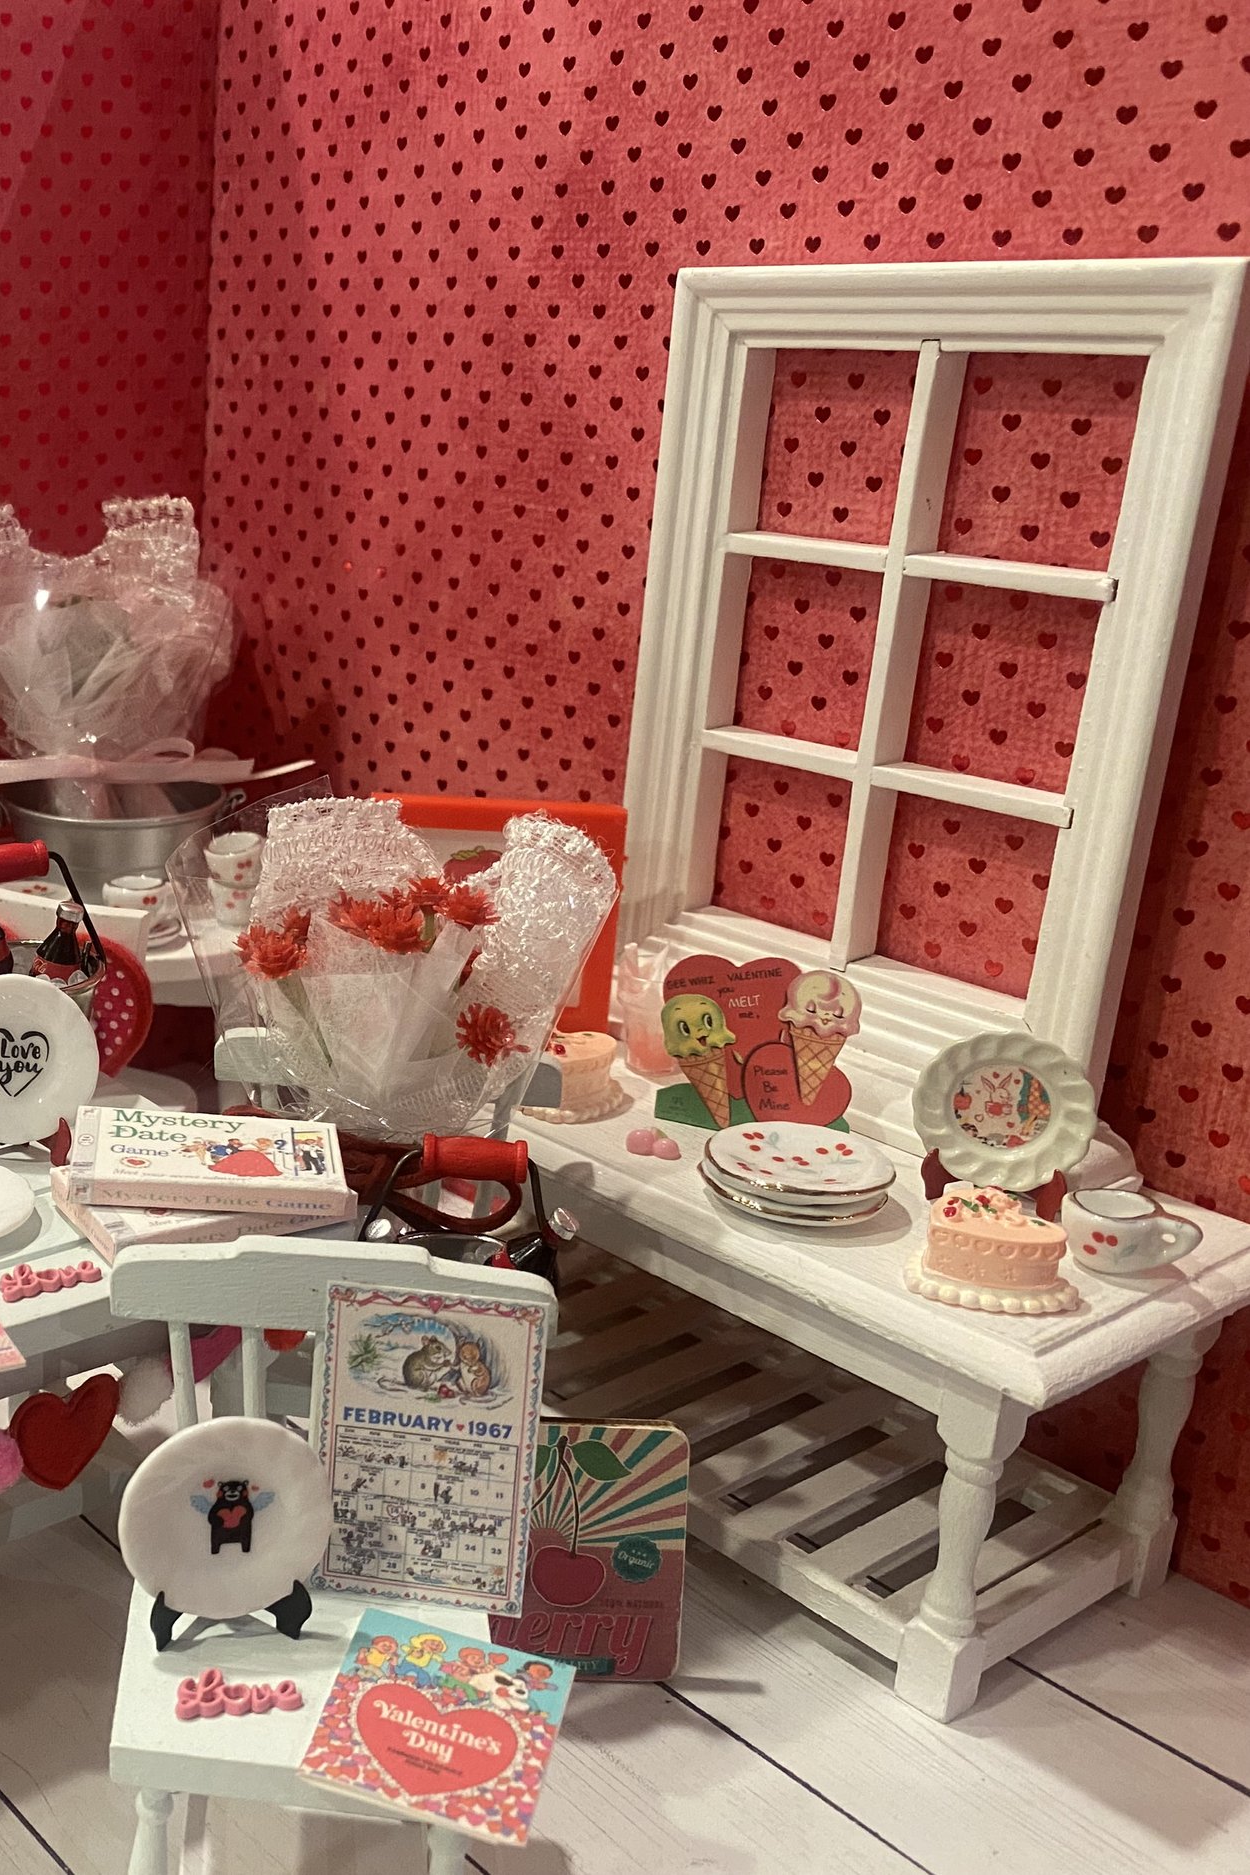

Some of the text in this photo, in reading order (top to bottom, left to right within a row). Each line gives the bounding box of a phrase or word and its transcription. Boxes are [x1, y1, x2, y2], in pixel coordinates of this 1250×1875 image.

[726, 967, 783, 982] VALENTINE
[728, 994, 761, 1009] MELT
[0, 1038, 41, 1060] Love
[753, 1065, 788, 1077] Please
[762, 1080, 778, 1093] Be
[759, 1098, 790, 1111] Mine
[113, 1108, 245, 1134] Mystery
[109, 1125, 188, 1143] Date
[110, 1143, 169, 1157] Game
[102, 1189, 332, 1211] Mystery Date Game
[343, 1406, 513, 1440] FEBRUARY 1967
[616, 1550, 656, 1570] Organic
[175, 1666, 303, 1722] Love
[373, 1699, 502, 1756] Valentine's
[402, 1729, 455, 1765] Day
